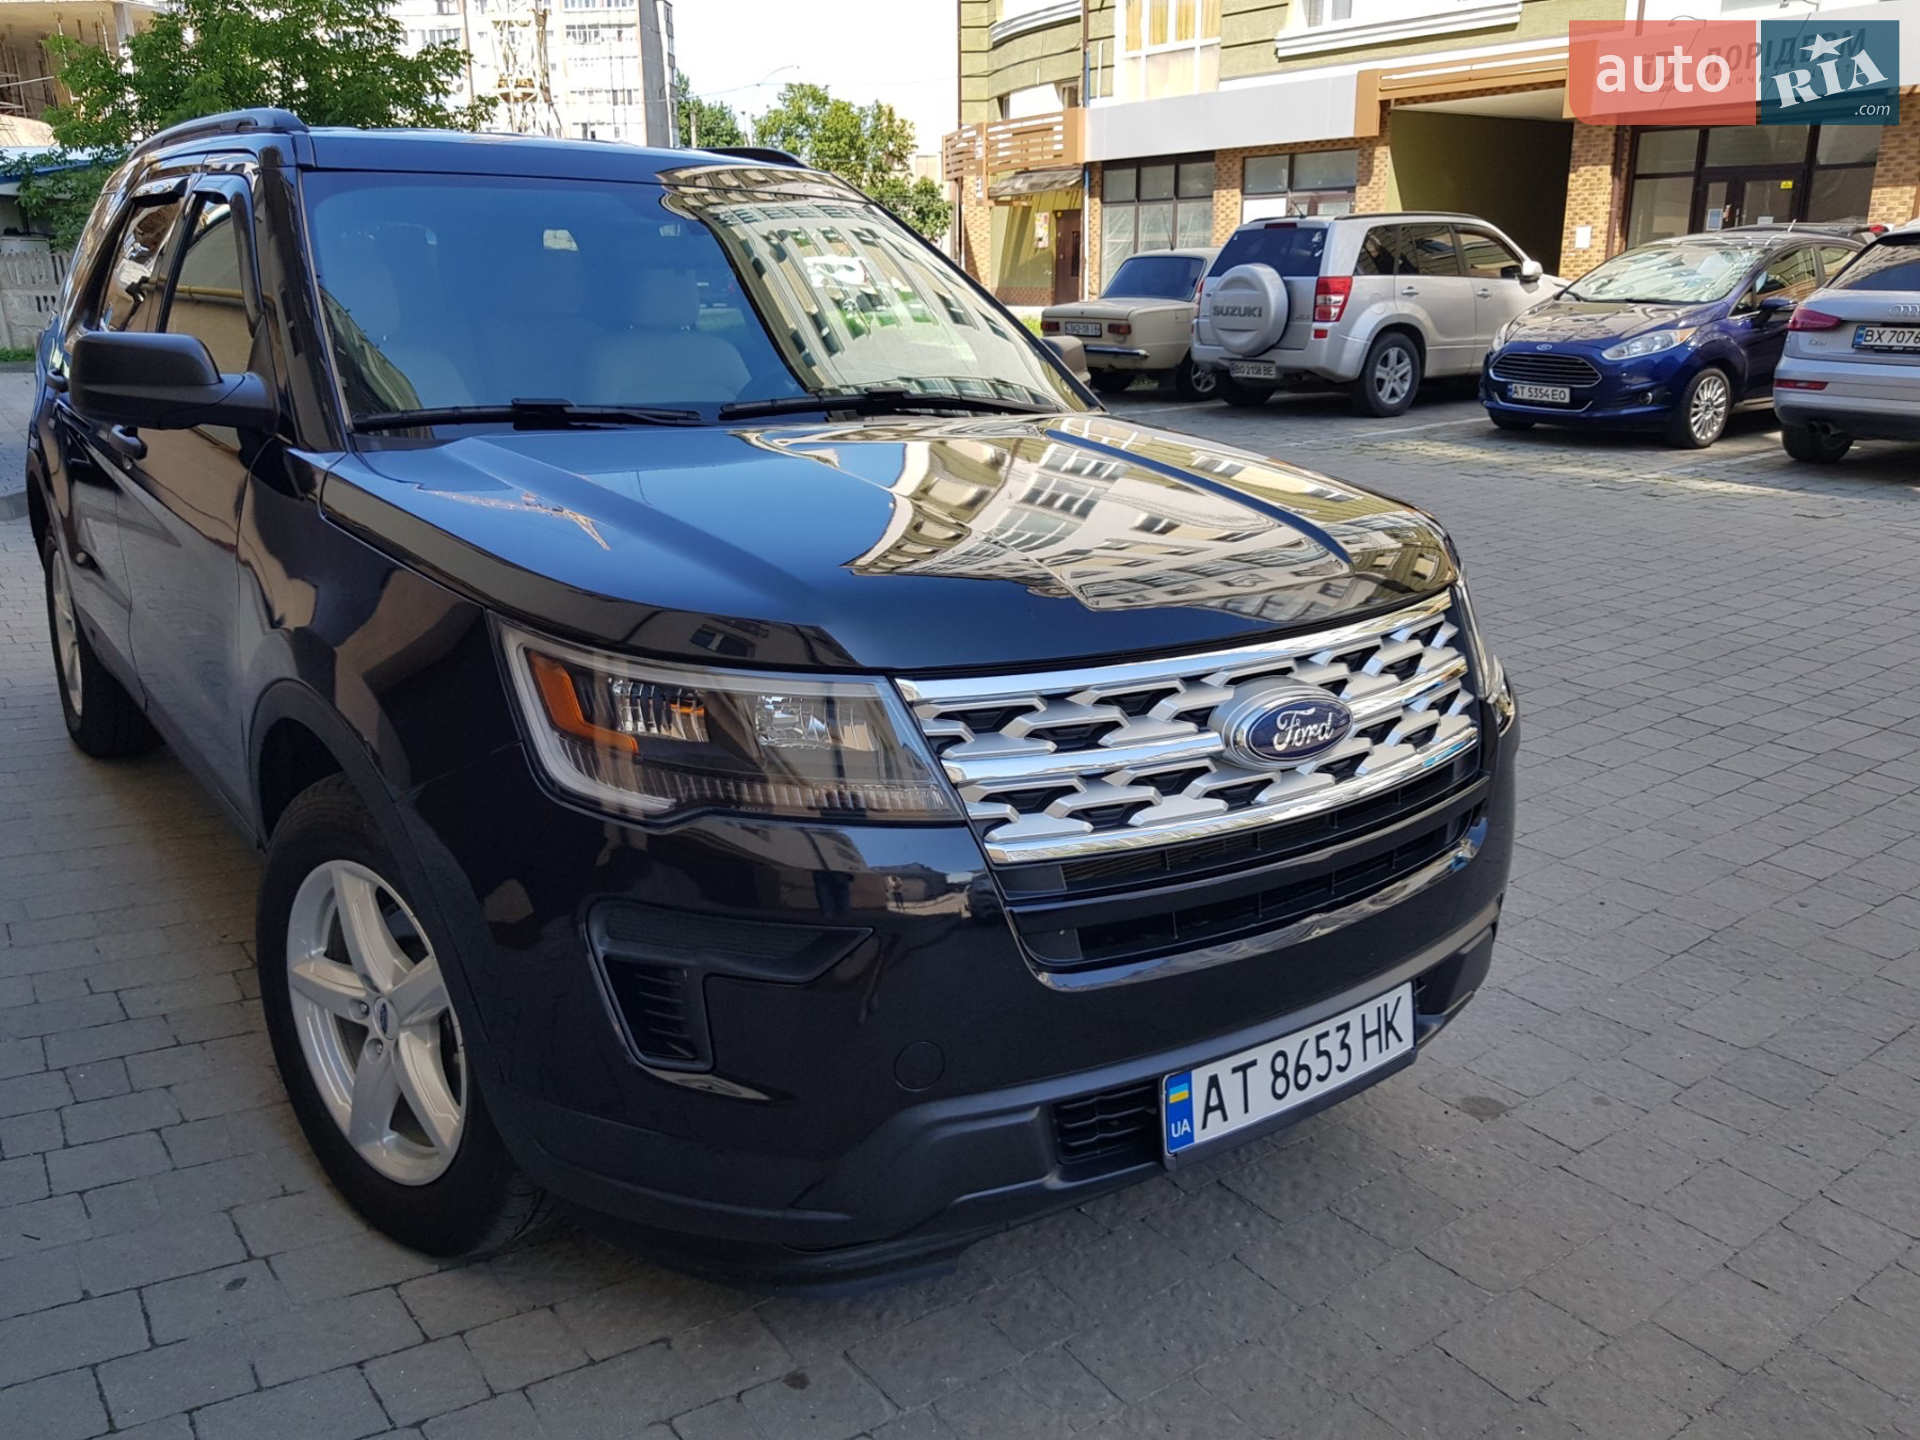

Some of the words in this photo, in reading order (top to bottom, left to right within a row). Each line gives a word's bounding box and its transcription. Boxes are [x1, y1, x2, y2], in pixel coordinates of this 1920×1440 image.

[1212, 305, 1263, 318] SUZUKI
[1863, 329, 1887, 343] BX
[1513, 385, 1526, 397] AT
[1528, 386, 1550, 400] 5354
[1273, 706, 1334, 752] Ford
[1201, 1058, 1258, 1131] AT
[1270, 1020, 1352, 1101] 8653
[1361, 995, 1404, 1062] HK
[1170, 1118, 1191, 1138] UA
